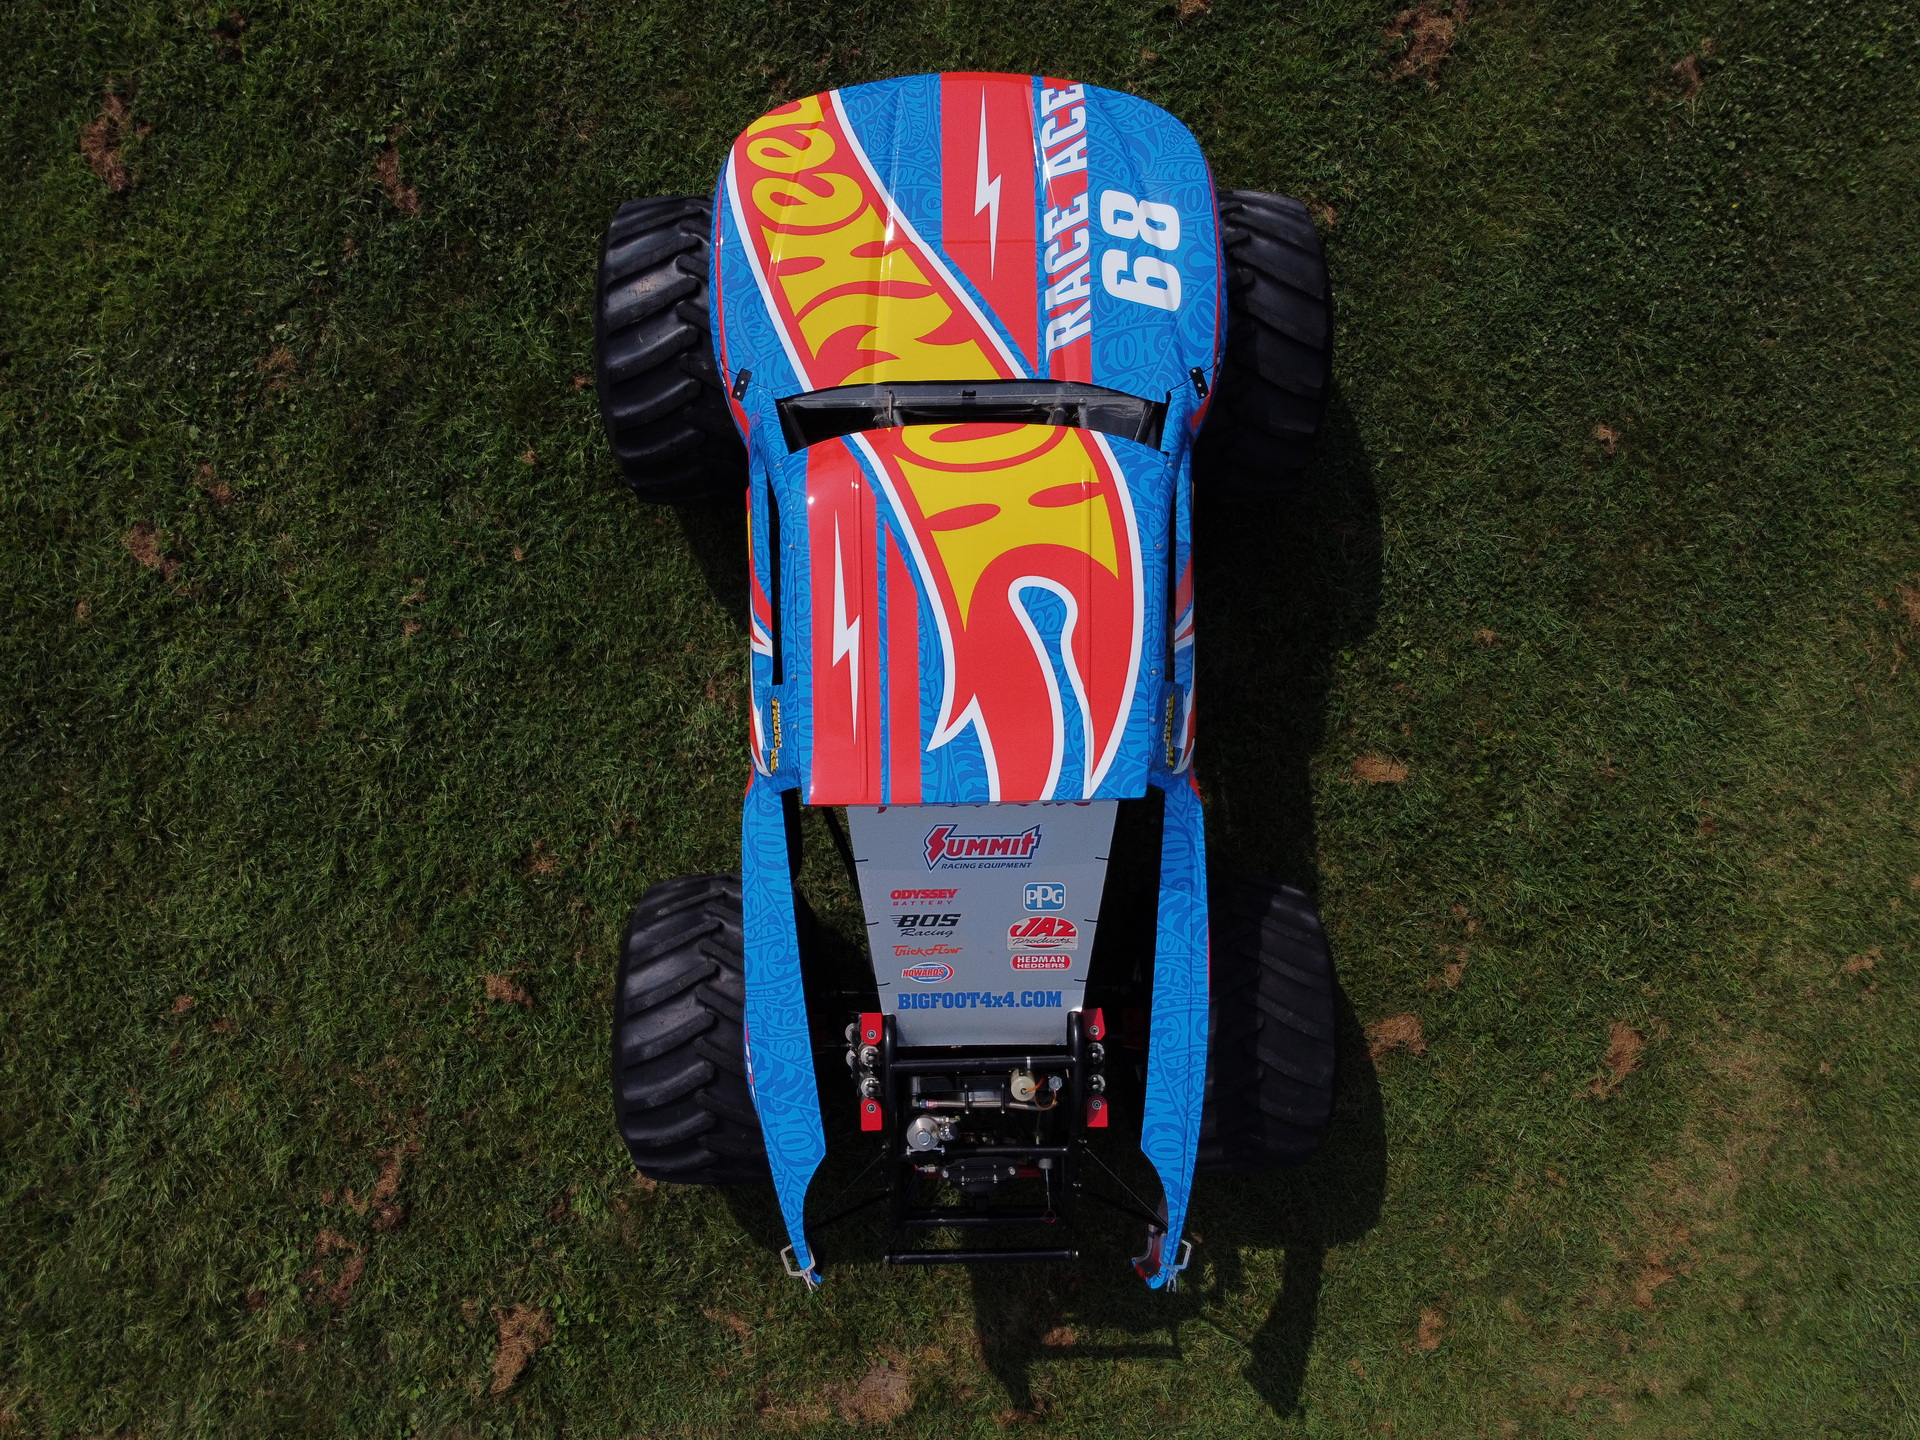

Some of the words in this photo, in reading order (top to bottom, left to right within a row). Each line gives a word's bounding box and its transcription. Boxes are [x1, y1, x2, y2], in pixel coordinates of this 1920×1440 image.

[1041, 83, 1088, 191] ACE
[1101, 189, 1181, 312] 68
[1044, 191, 1091, 362] RACE
[941, 862, 976, 870] RACING
[977, 861, 1032, 869] EQUIPMENT
[890, 888, 958, 900] ODYSSEY
[1025, 885, 1064, 909] PPG
[896, 913, 962, 928] BOS
[1009, 916, 1077, 937] JAZ
[900, 928, 955, 939] Racing
[902, 967, 945, 978] HOWARDS
[897, 990, 1063, 1010] BIGFOOT4x4.COM
